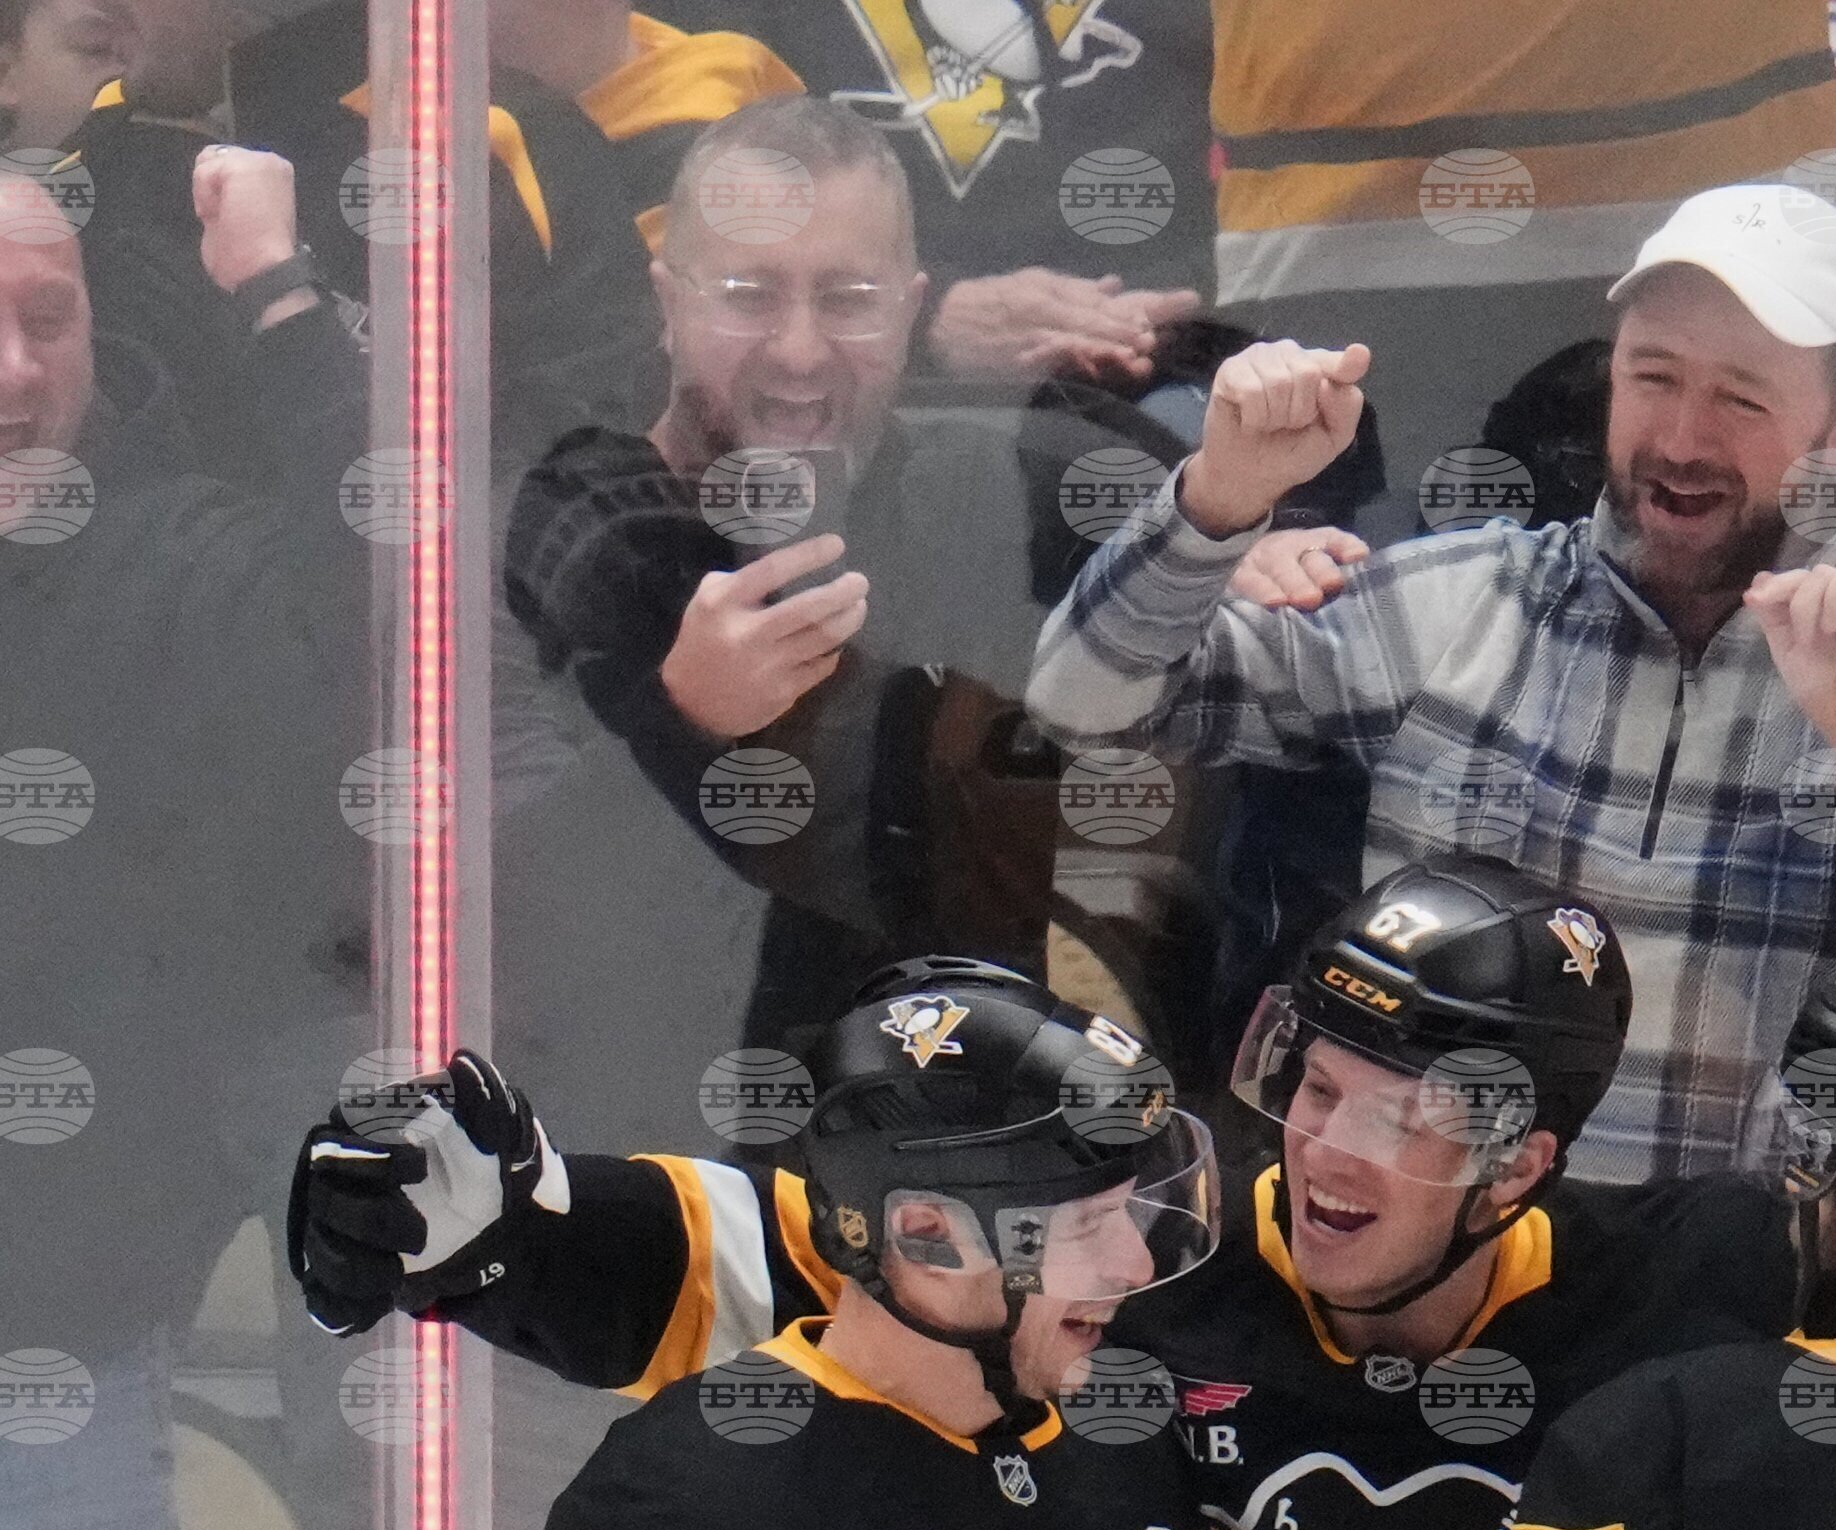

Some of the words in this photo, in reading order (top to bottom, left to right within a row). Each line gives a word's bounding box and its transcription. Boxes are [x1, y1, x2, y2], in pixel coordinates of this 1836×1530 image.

[1364, 902, 1442, 954] 67
[1323, 965, 1402, 1013] CCM
[479, 1262, 506, 1287] 67
